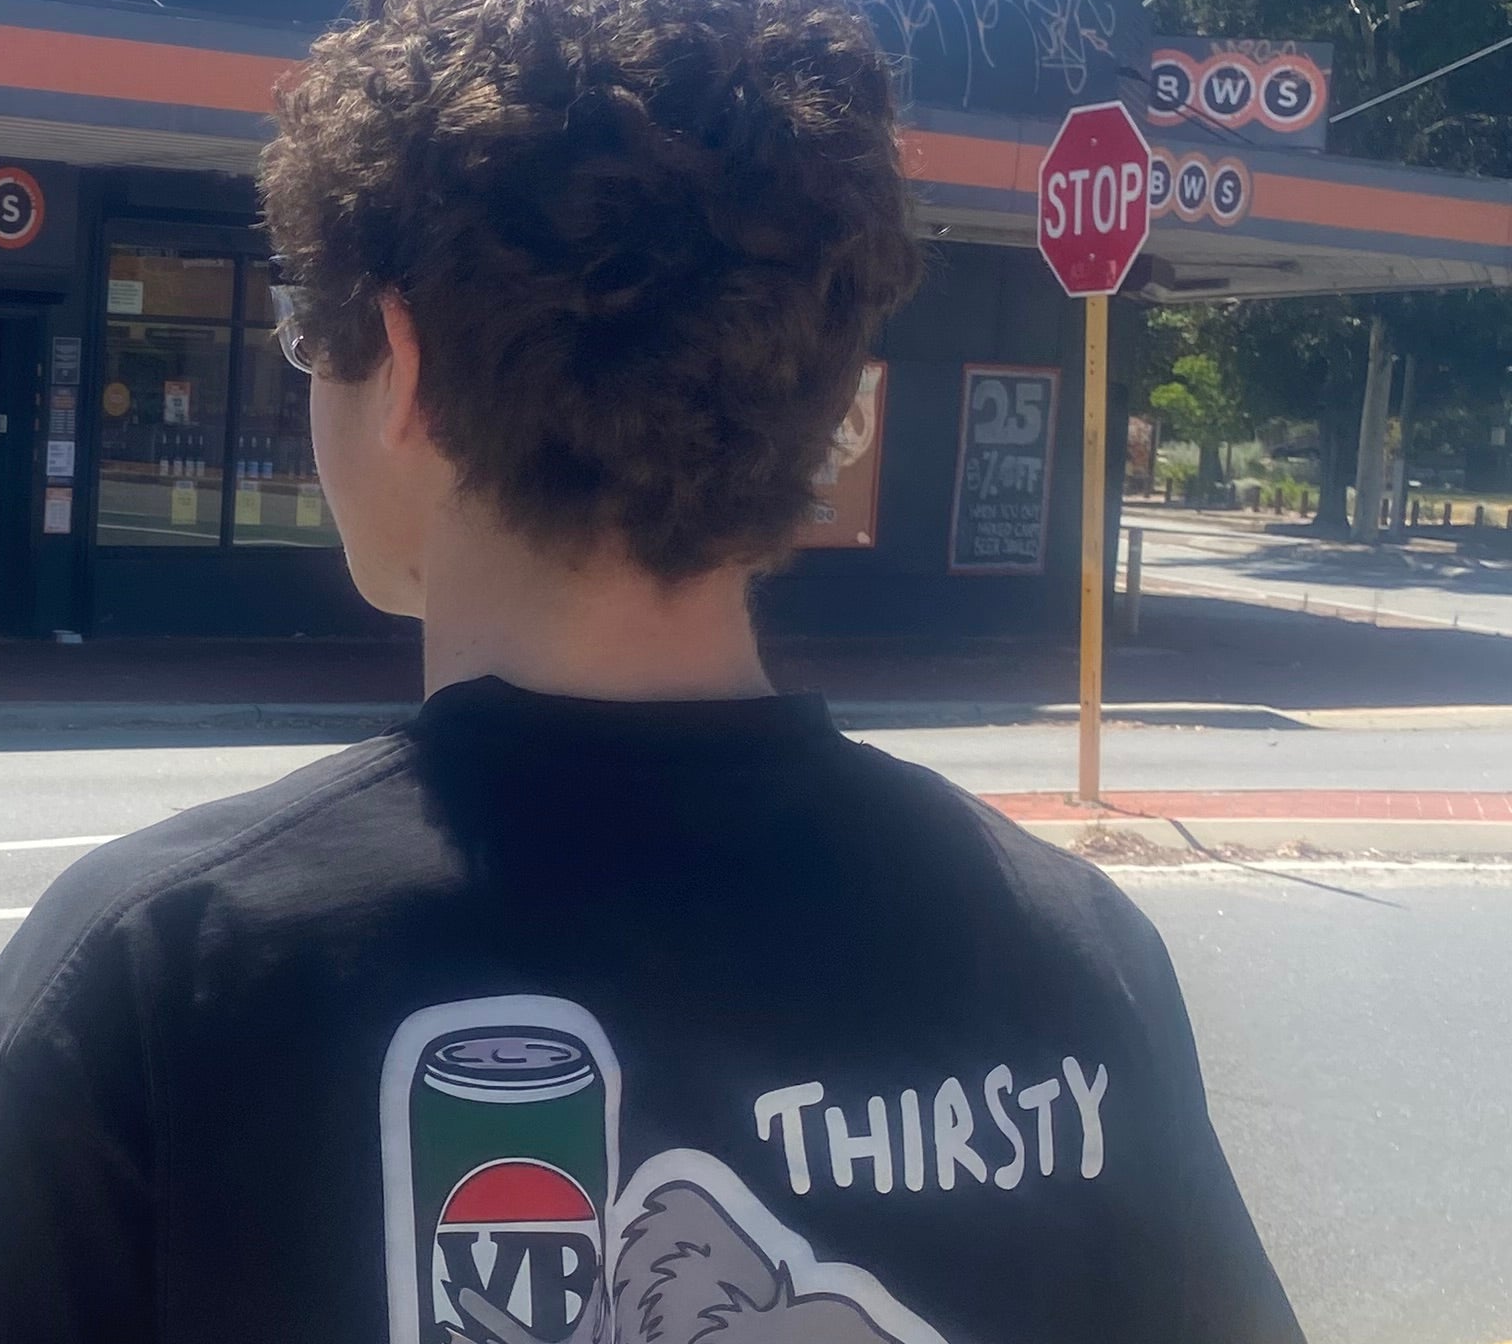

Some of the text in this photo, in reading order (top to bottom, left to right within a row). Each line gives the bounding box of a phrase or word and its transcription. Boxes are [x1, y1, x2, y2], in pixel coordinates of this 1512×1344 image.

[1156, 74, 1299, 108] BWS
[1044, 161, 1144, 239] STOP
[1150, 170, 1235, 205] BWS
[972, 379, 1043, 445] 25
[754, 1056, 1108, 1195] THIRSTY
